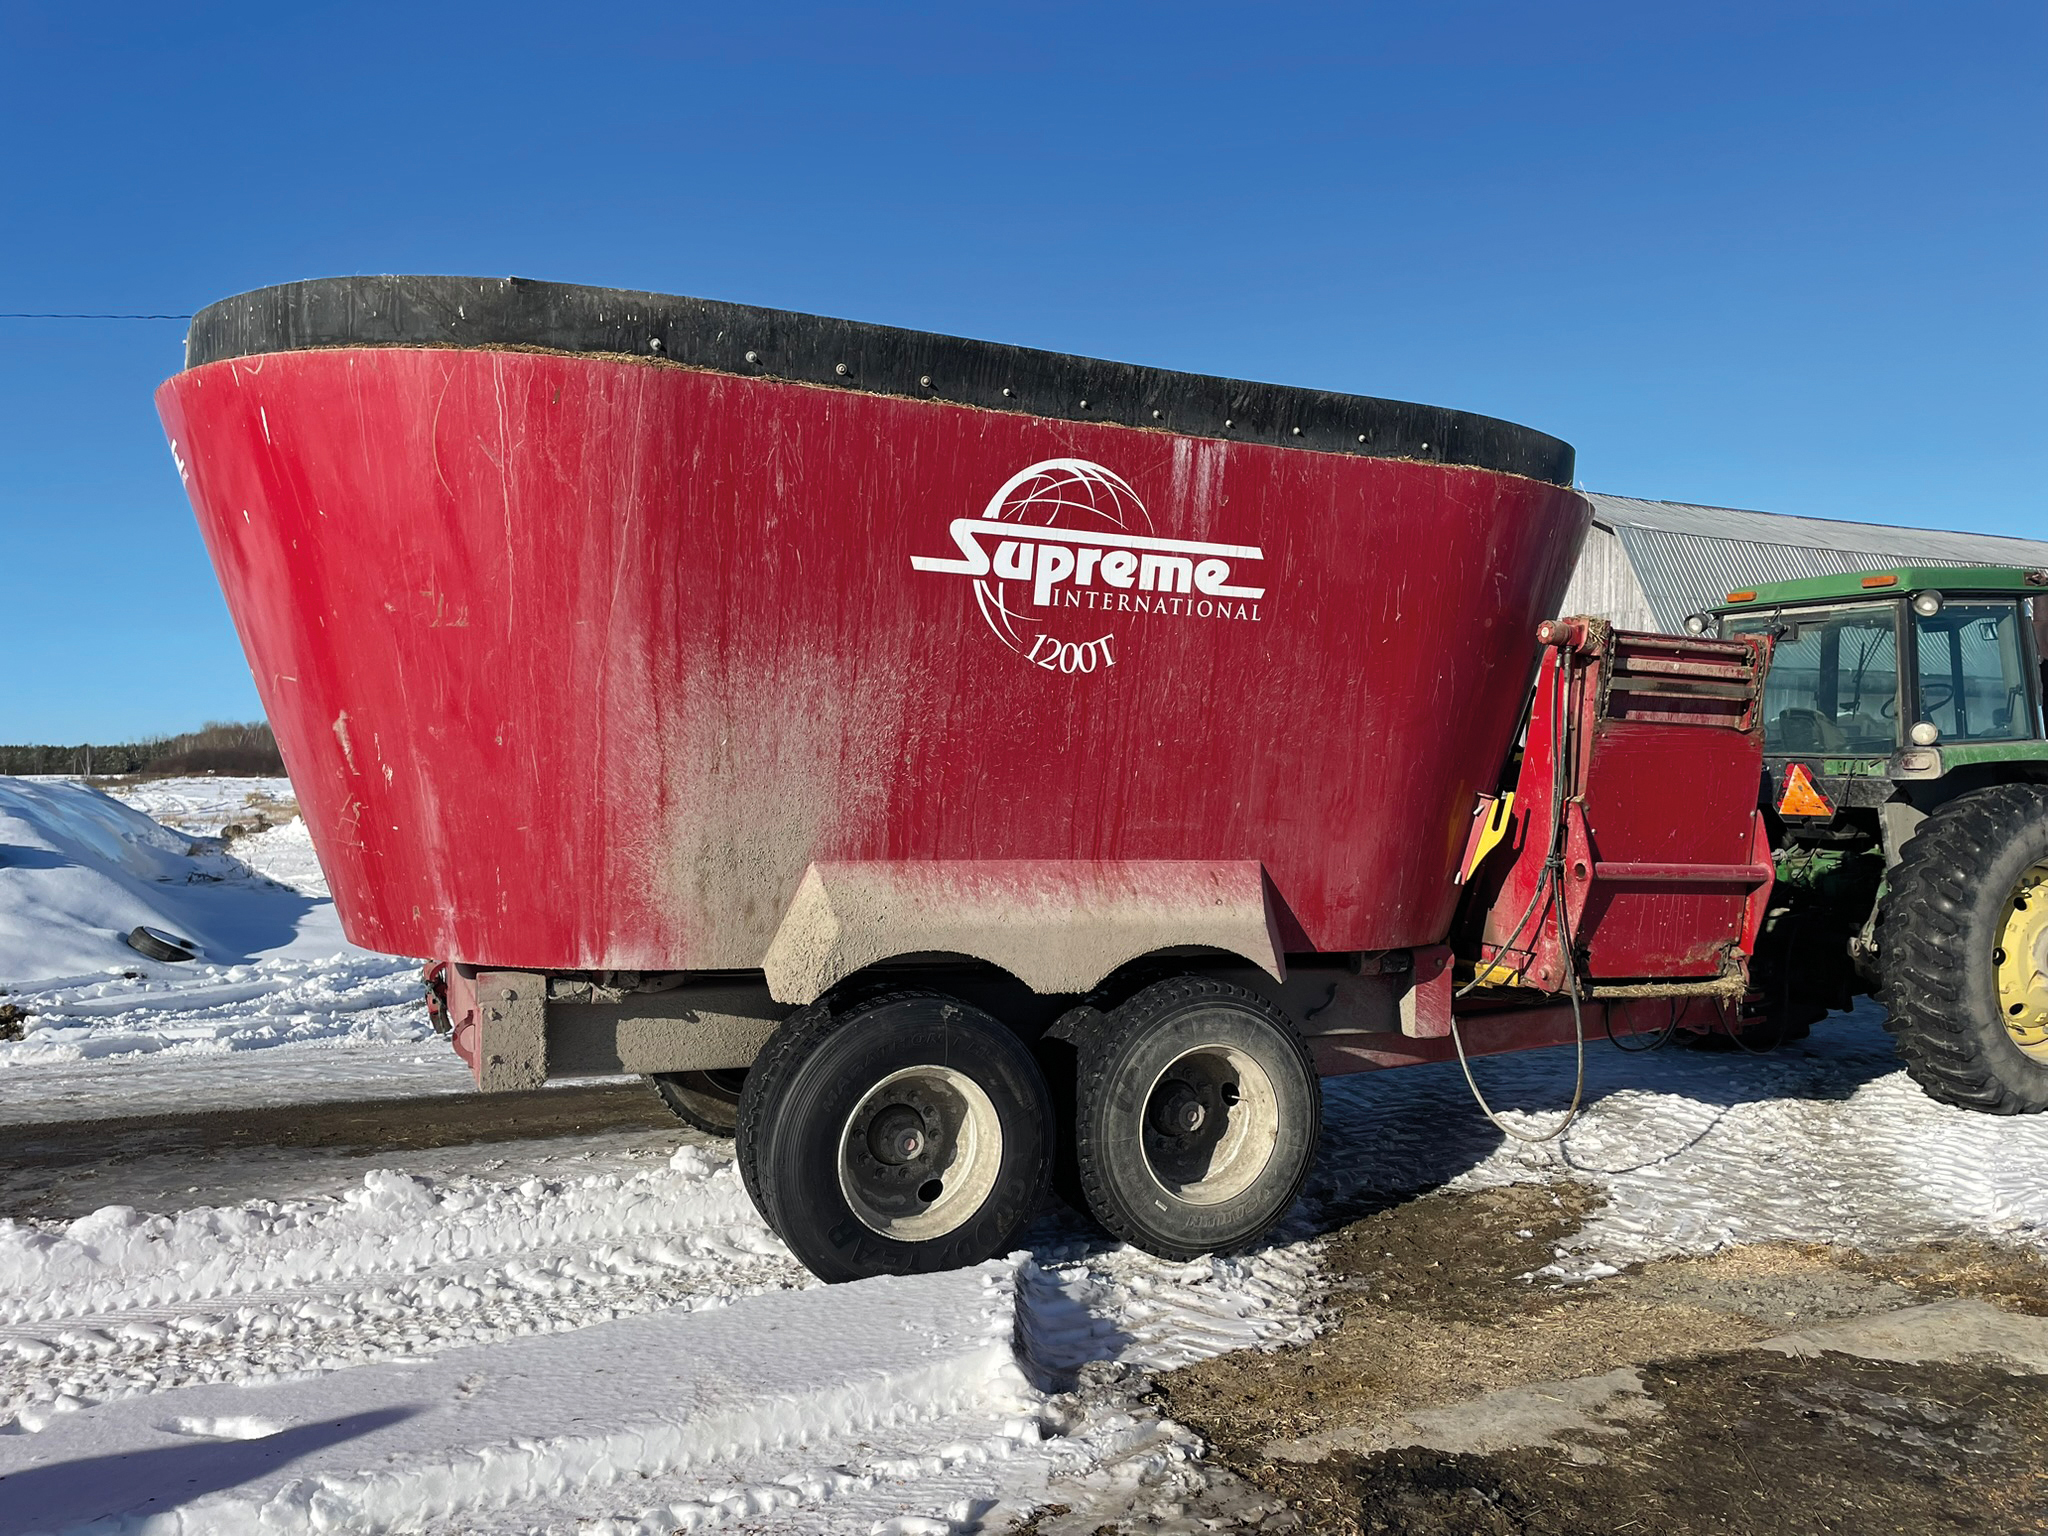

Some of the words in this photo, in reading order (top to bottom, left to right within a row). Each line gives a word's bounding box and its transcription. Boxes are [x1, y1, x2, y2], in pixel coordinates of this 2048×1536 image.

[909, 517, 1266, 607] Supreme
[1053, 588, 1262, 621] INTERNATIONAL
[1023, 633, 1117, 674] 1200T
